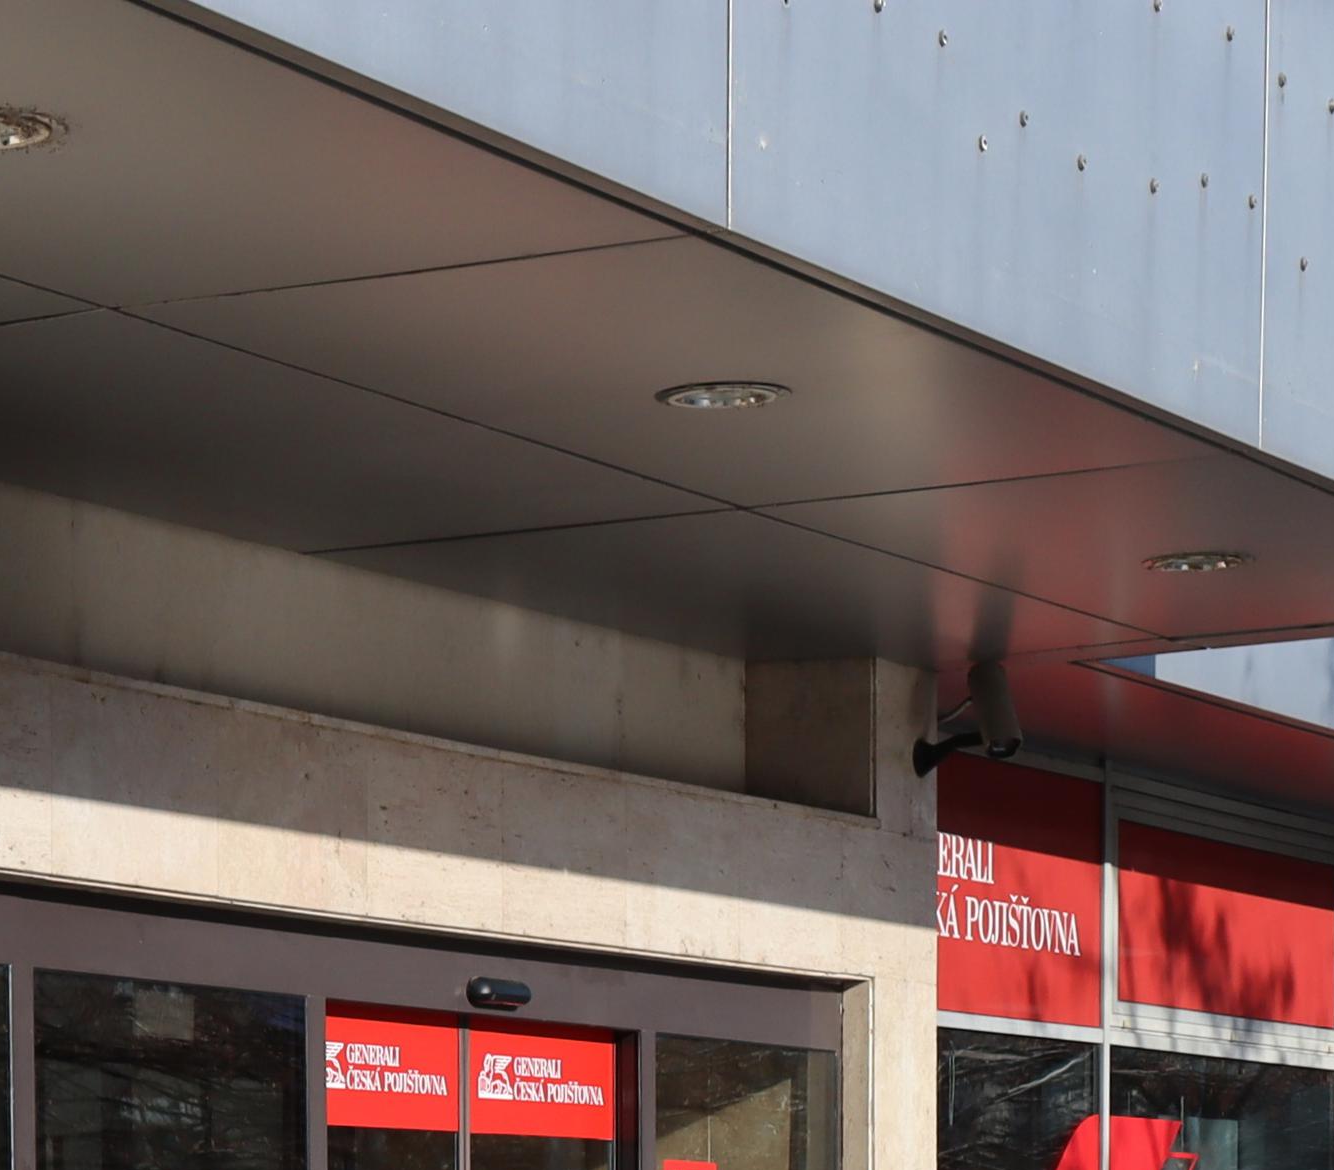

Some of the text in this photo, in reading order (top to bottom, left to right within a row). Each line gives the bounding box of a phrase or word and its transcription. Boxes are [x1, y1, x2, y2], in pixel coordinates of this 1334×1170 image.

[965, 894, 1080, 956] POJIŠŤOVNA
[346, 1043, 400, 1067] GENERALI
[513, 1056, 562, 1079] GENERALI
[346, 1065, 448, 1096] ČESKÁ POJIŠŤOVNA
[513, 1077, 604, 1106] ČESKÁ POJIŠŤOVNA
